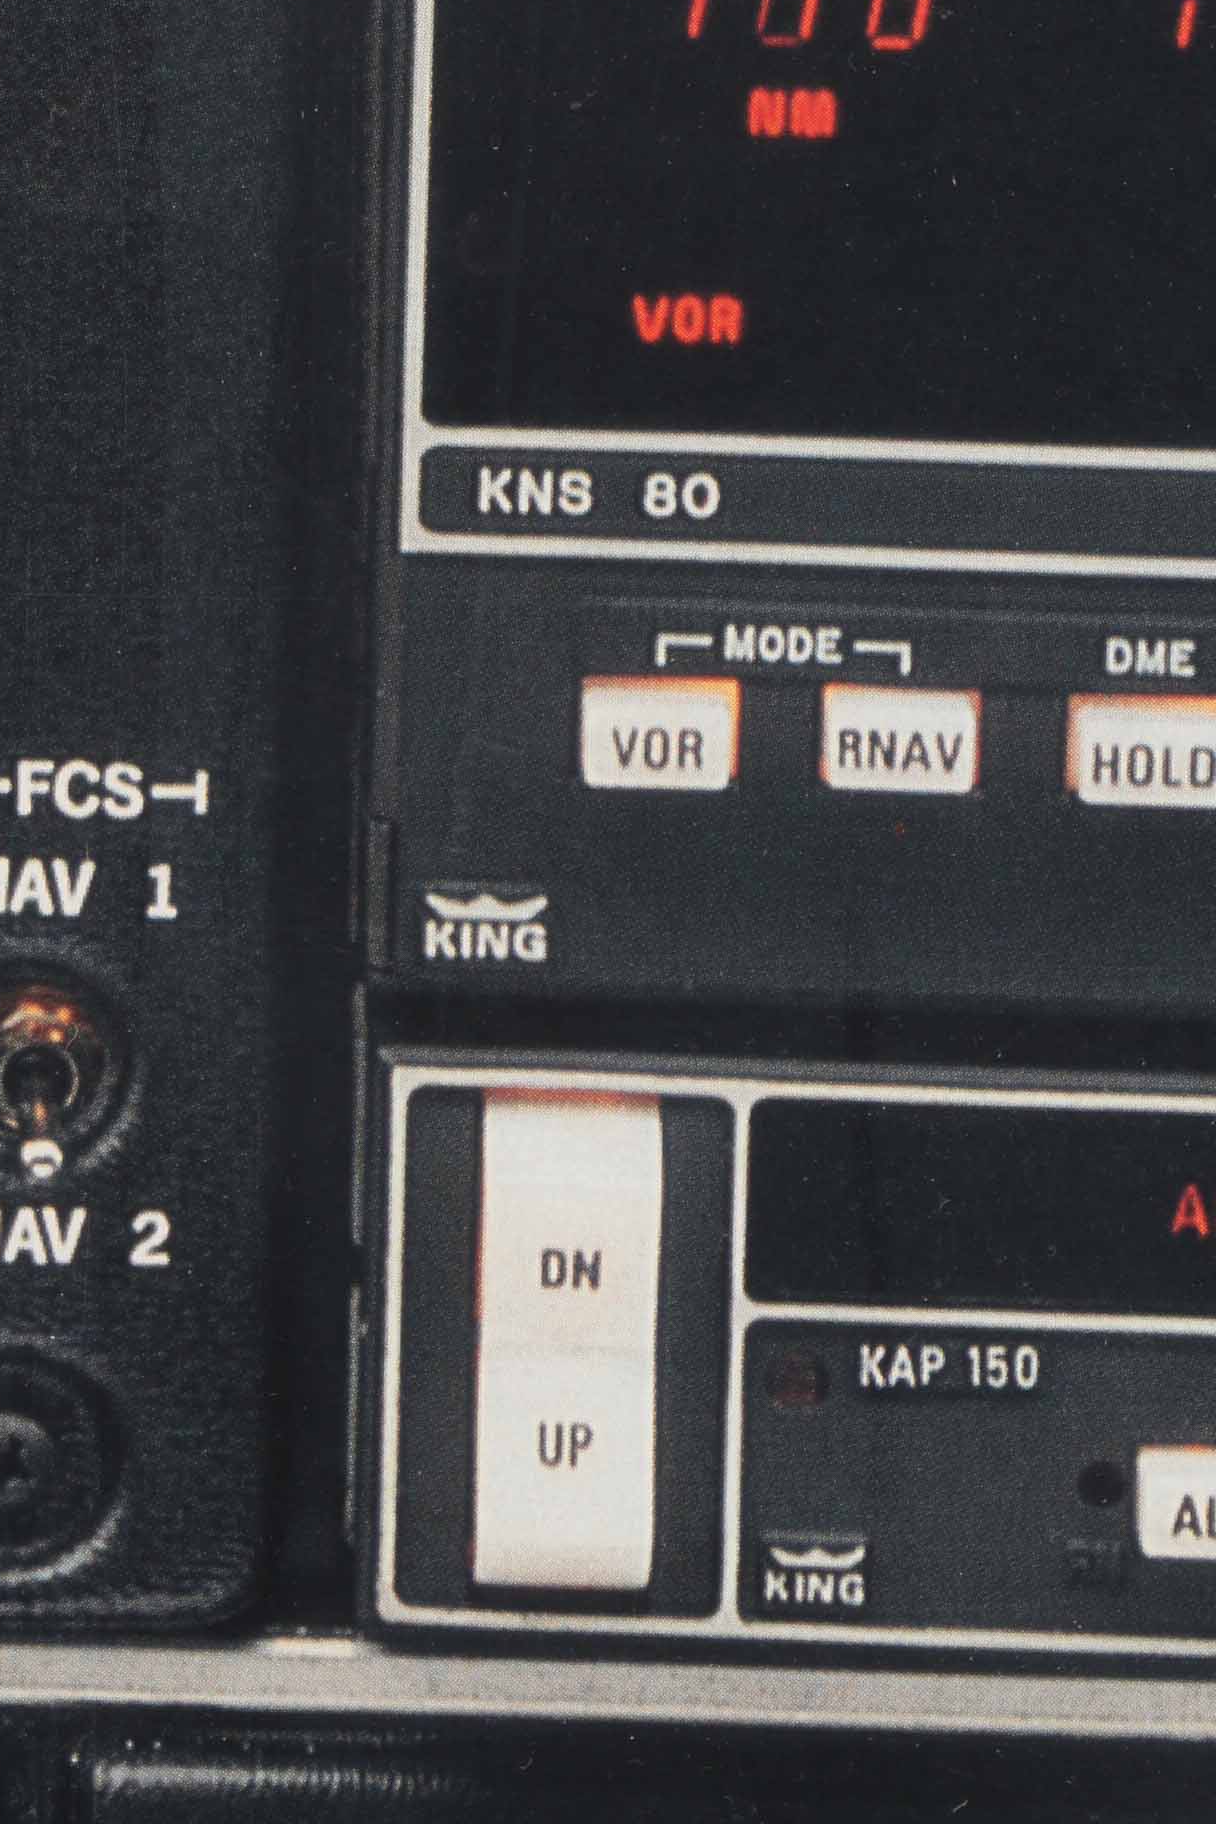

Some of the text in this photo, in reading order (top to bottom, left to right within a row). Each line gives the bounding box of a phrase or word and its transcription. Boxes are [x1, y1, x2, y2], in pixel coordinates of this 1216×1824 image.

[747, 87, 838, 139] NM
[632, 293, 743, 344] VOR
[478, 466, 721, 519] KNS 80
[723, 623, 843, 665] MODE
[1105, 636, 1196, 678] DME
[612, 727, 704, 772] VOR
[838, 728, 963, 773] RNAV
[1092, 743, 1216, 789] HOLD
[16, 759, 145, 820] FCS
[146, 863, 178, 920] 1
[424, 919, 547, 962] KING
[129, 1210, 171, 1267] 2
[540, 1248, 602, 1290] DN
[859, 1344, 1040, 1390] KAP 150
[538, 1422, 594, 1468] UP
[764, 1574, 865, 1606] KING
